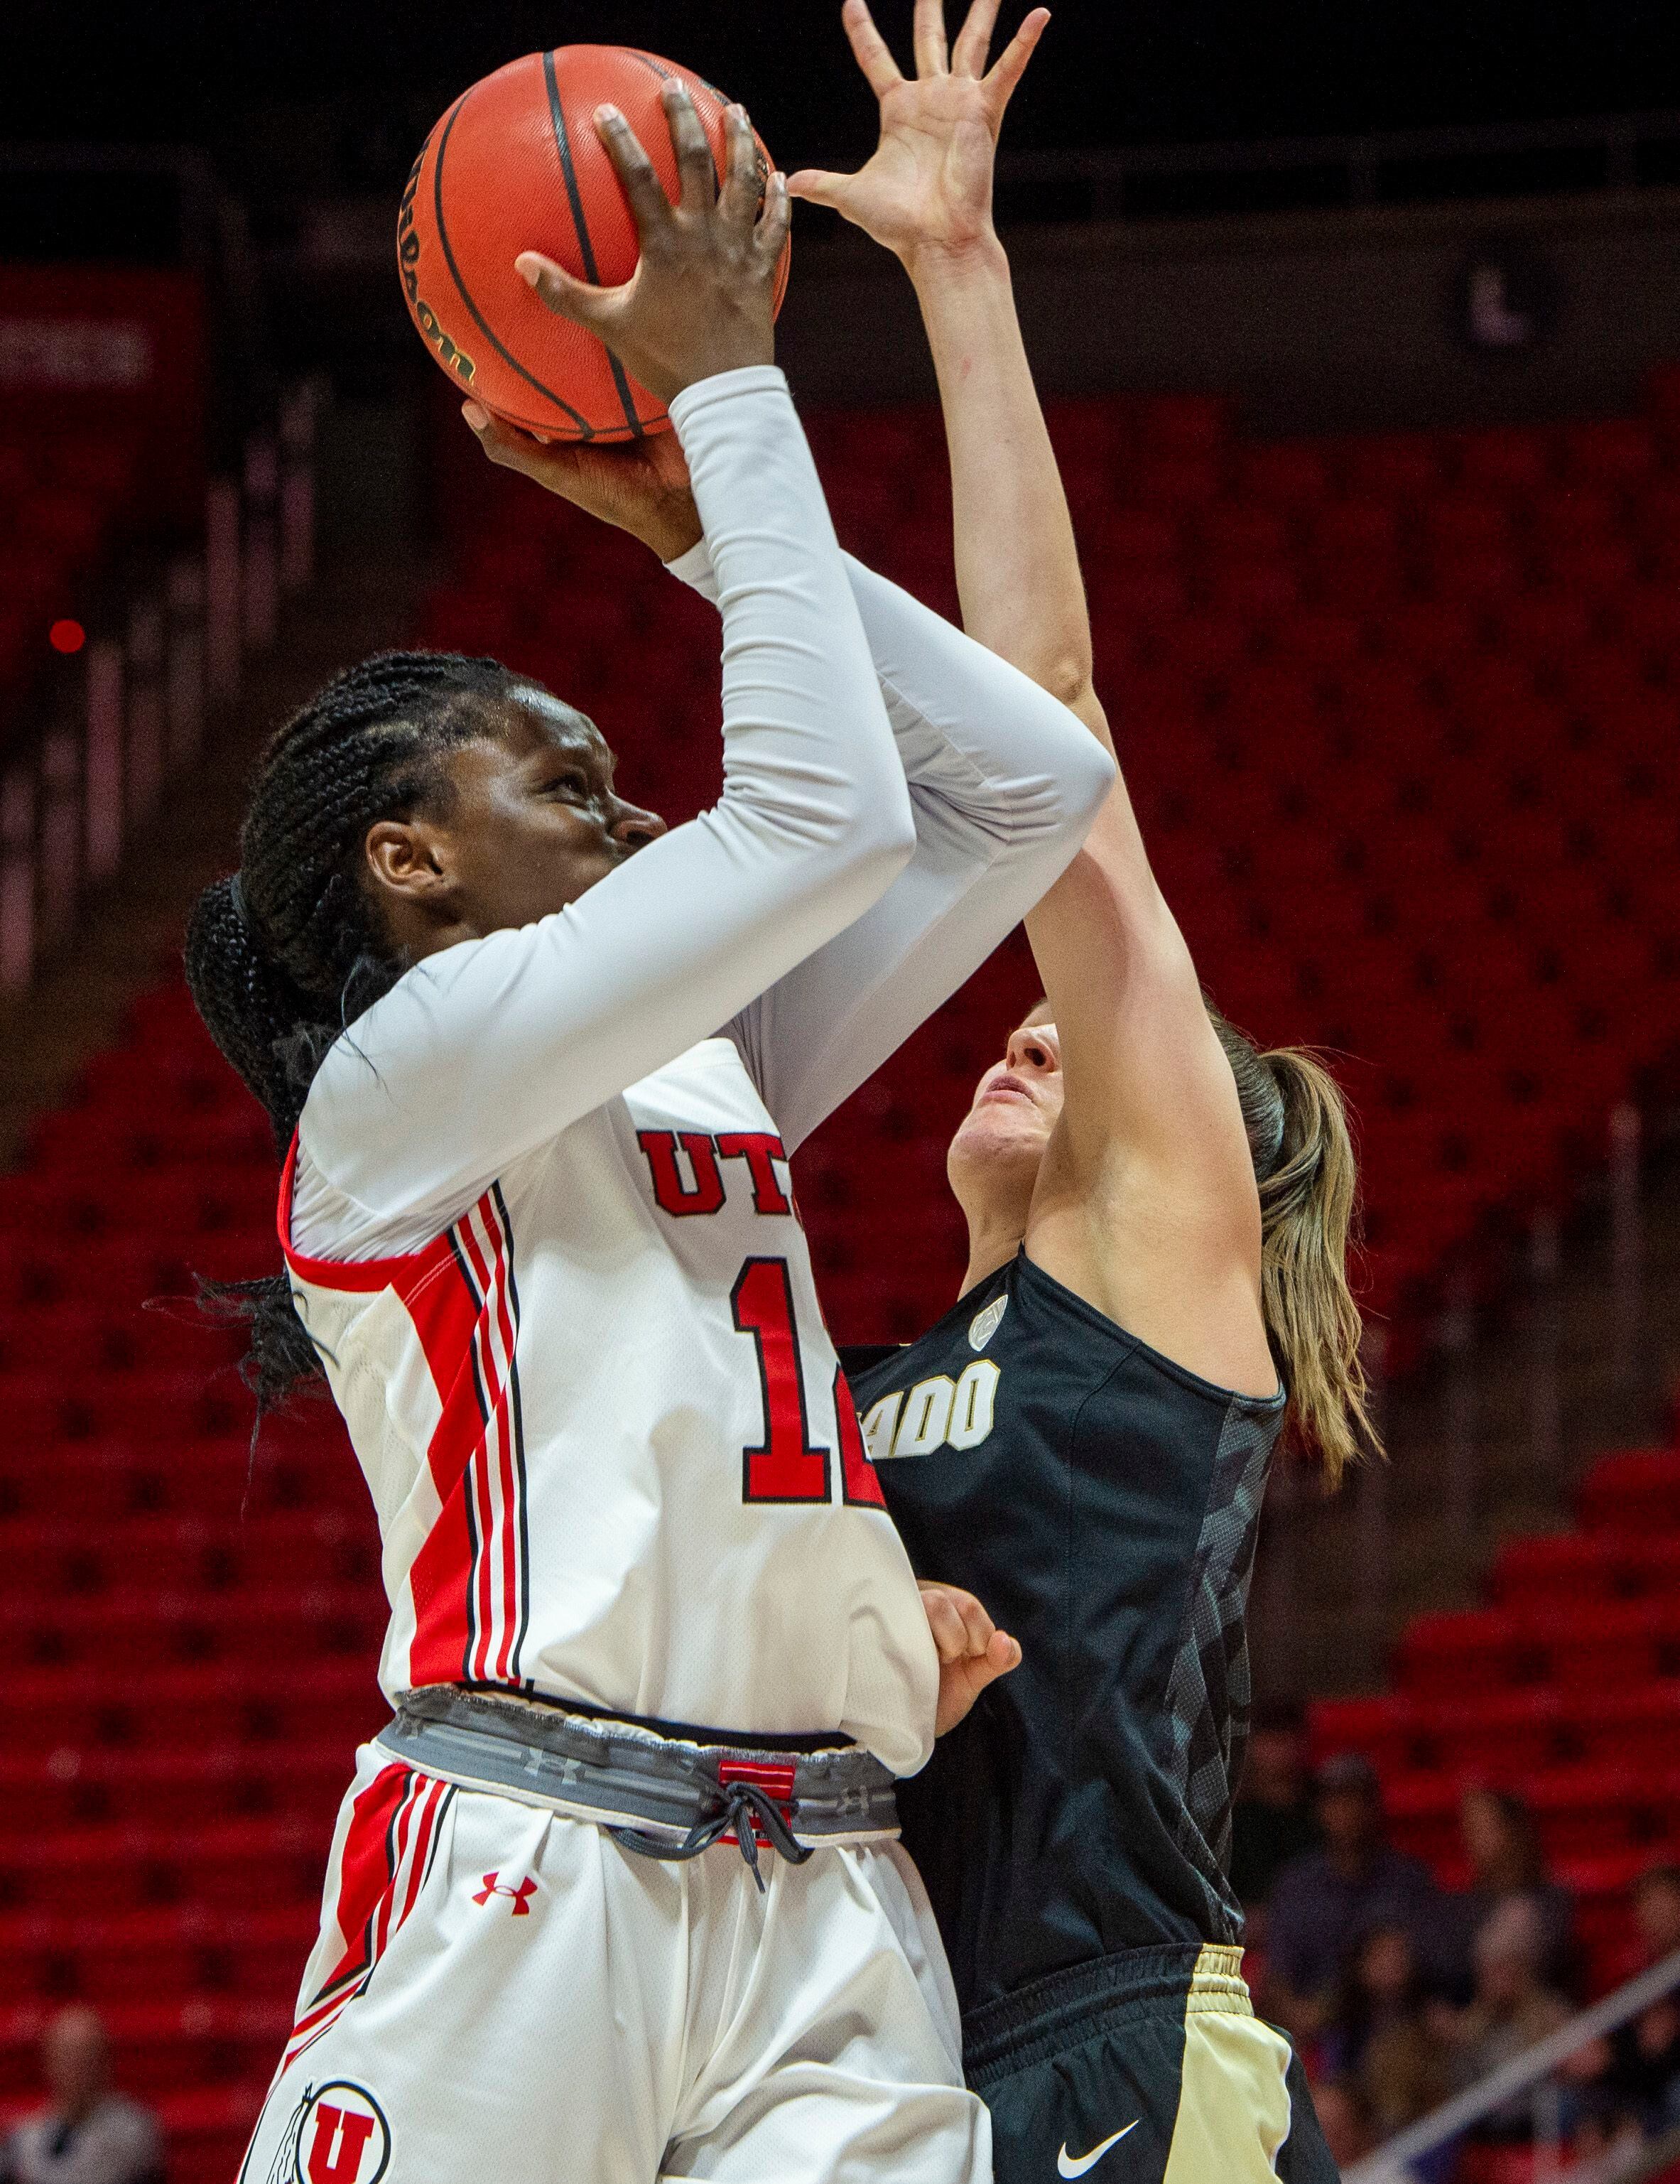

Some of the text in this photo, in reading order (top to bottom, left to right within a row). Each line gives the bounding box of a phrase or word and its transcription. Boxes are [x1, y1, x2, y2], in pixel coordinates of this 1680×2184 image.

[636, 1130, 793, 1216] UT
[856, 1358, 1001, 1460] ADO
[308, 2102, 375, 2184] U
